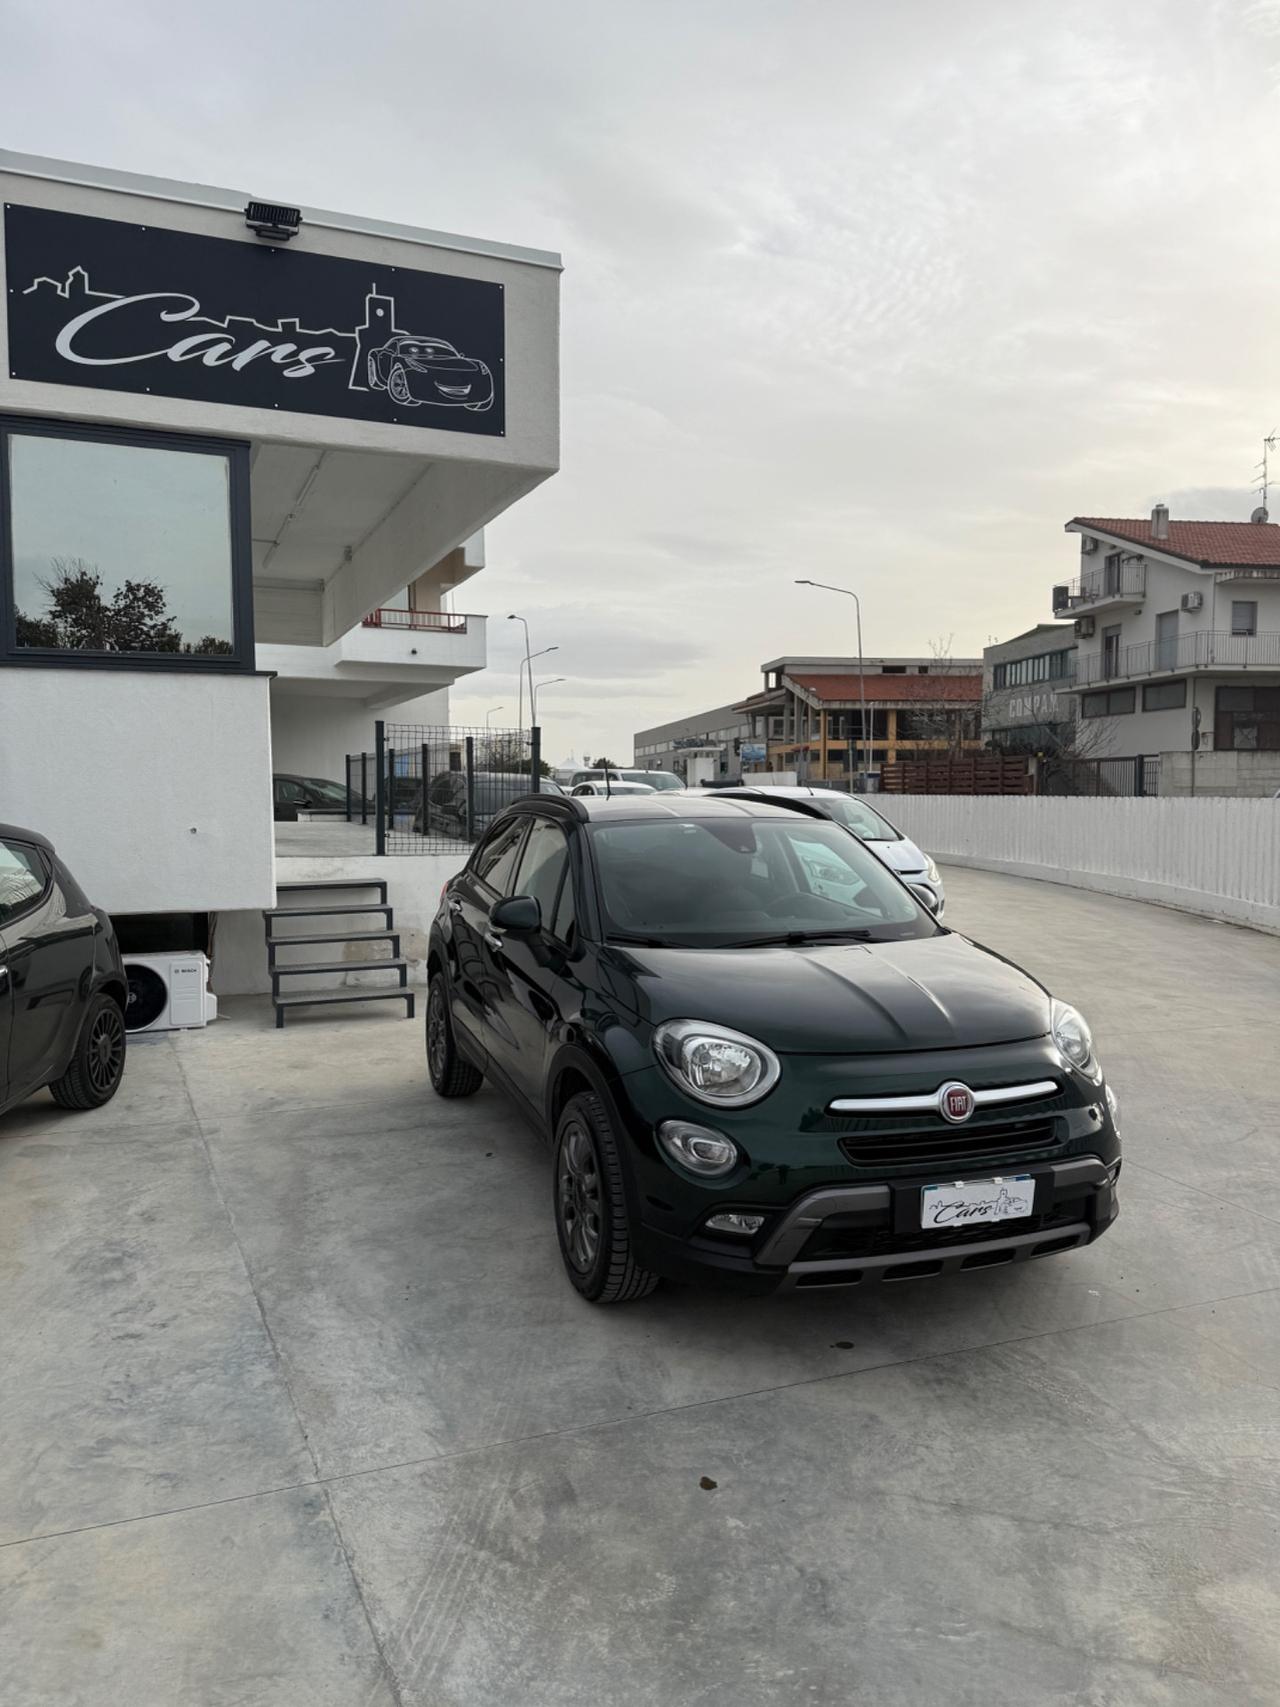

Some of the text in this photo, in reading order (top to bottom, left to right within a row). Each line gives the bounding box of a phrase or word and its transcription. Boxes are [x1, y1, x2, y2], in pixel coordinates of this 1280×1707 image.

[56, 293, 344, 378] Cars
[950, 1096, 967, 1112] FIAT
[934, 1201, 992, 1224] Cars
